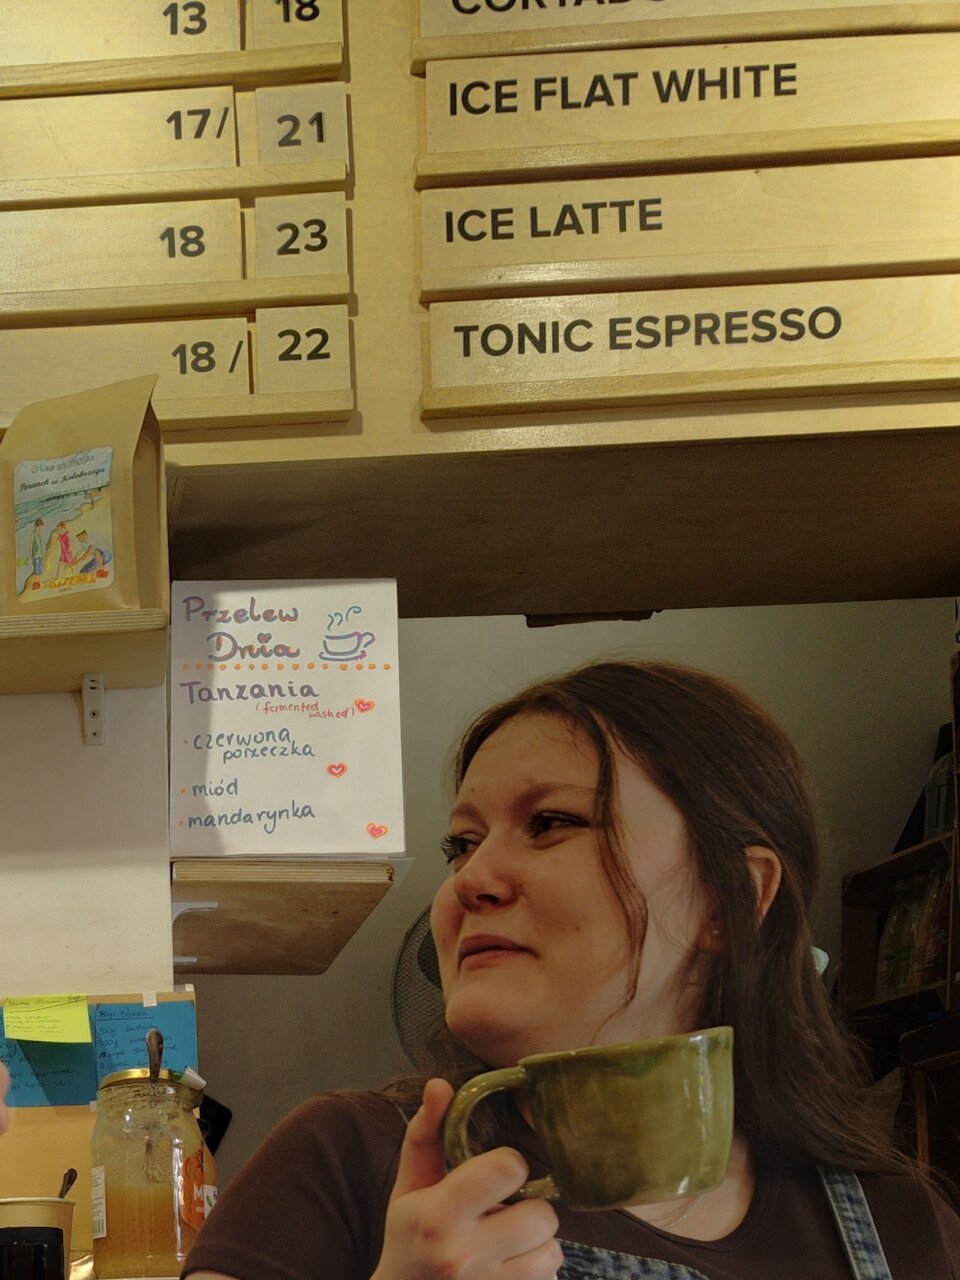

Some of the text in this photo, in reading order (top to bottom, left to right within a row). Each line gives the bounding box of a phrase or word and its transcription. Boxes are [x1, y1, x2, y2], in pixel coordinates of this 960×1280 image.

[162, 1, 208, 36] 13
[277, 0, 320, 23] 18
[449, 63, 798, 116] ICE FLAT WHITE
[277, 111, 325, 147] 21
[276, 218, 328, 255] 23
[445, 198, 663, 243] ICE LATTE
[159, 225, 206, 259] 18
[277, 328, 331, 361] 22
[454, 306, 842, 358] TONIC ESPRESSO
[182, 595, 299, 625] Przelew
[205, 631, 301, 663] Dnia
[180, 680, 320, 705] Tanzania
[193, 727, 292, 750] czerwona
[192, 778, 239, 798] miód
[188, 799, 316, 835] mandarynka
